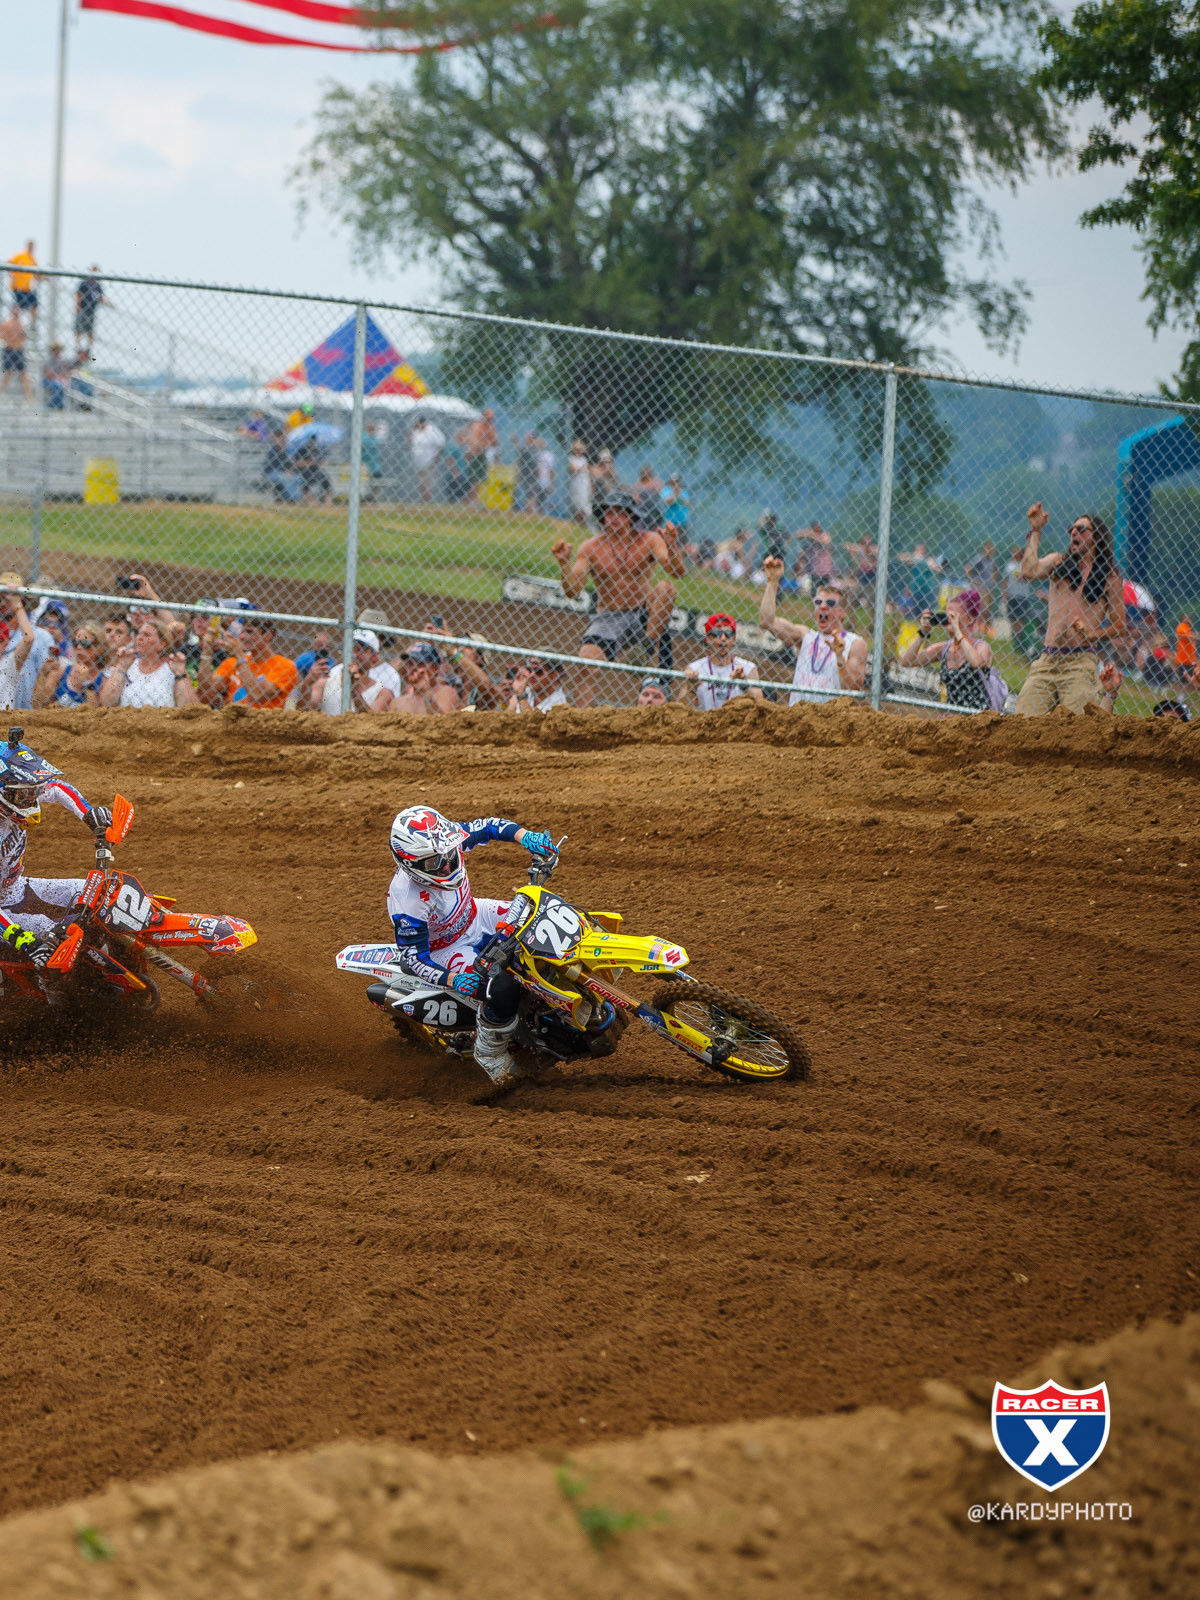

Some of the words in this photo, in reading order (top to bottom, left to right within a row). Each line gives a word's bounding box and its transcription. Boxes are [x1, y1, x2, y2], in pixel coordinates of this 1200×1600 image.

[112, 884, 151, 931] 12
[535, 899, 580, 959] 26
[373, 968, 392, 978] PIRELLI
[588, 983, 629, 1009] SHOWA
[423, 1000, 457, 1026] 26
